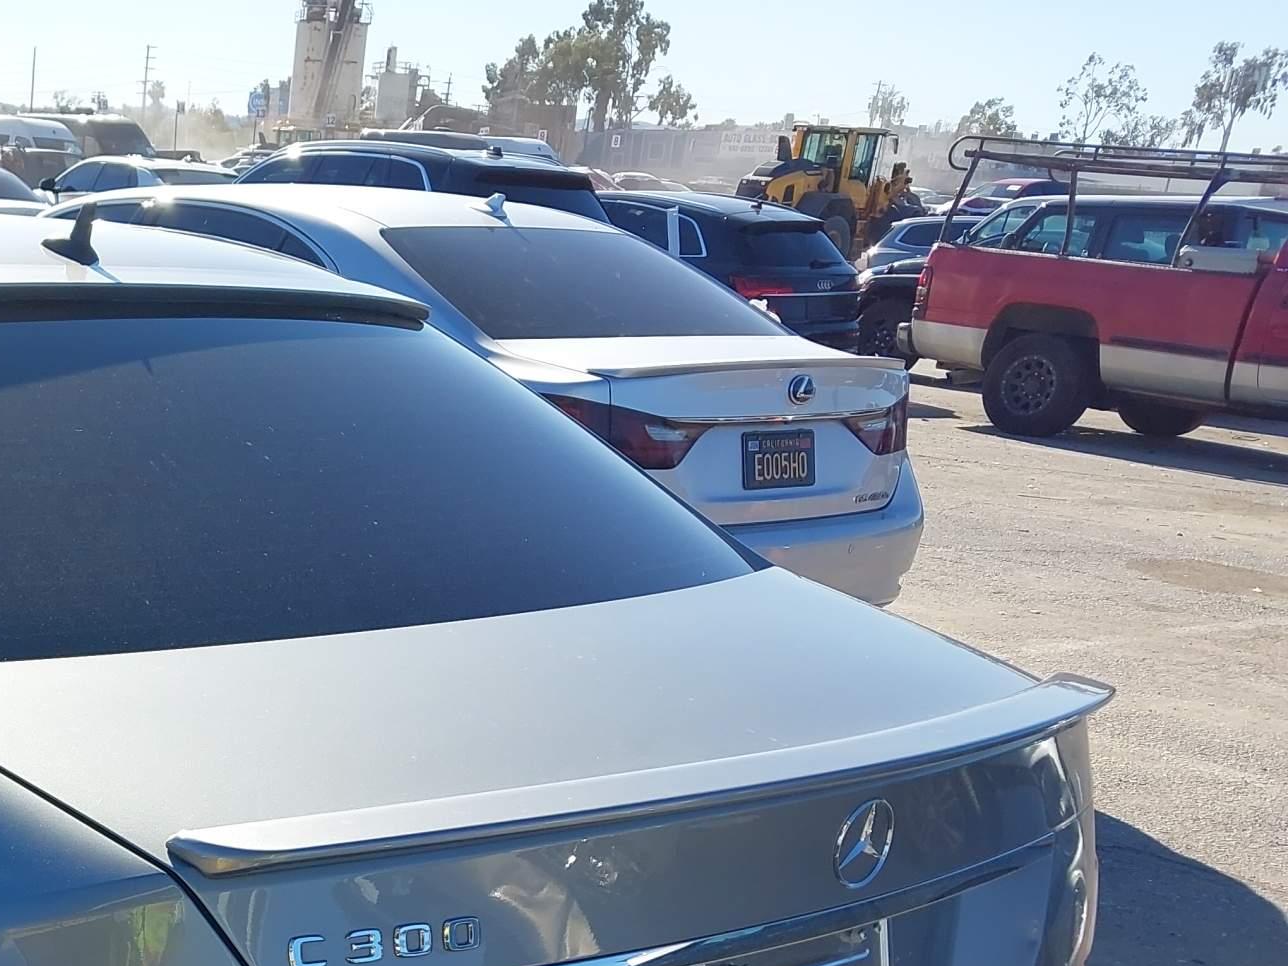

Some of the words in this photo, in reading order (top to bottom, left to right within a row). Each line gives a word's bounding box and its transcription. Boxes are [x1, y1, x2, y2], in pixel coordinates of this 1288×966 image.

[327, 116, 336, 125] 12
[762, 437, 801, 449] CALIFORNIA
[344, 916, 481, 965] 300
